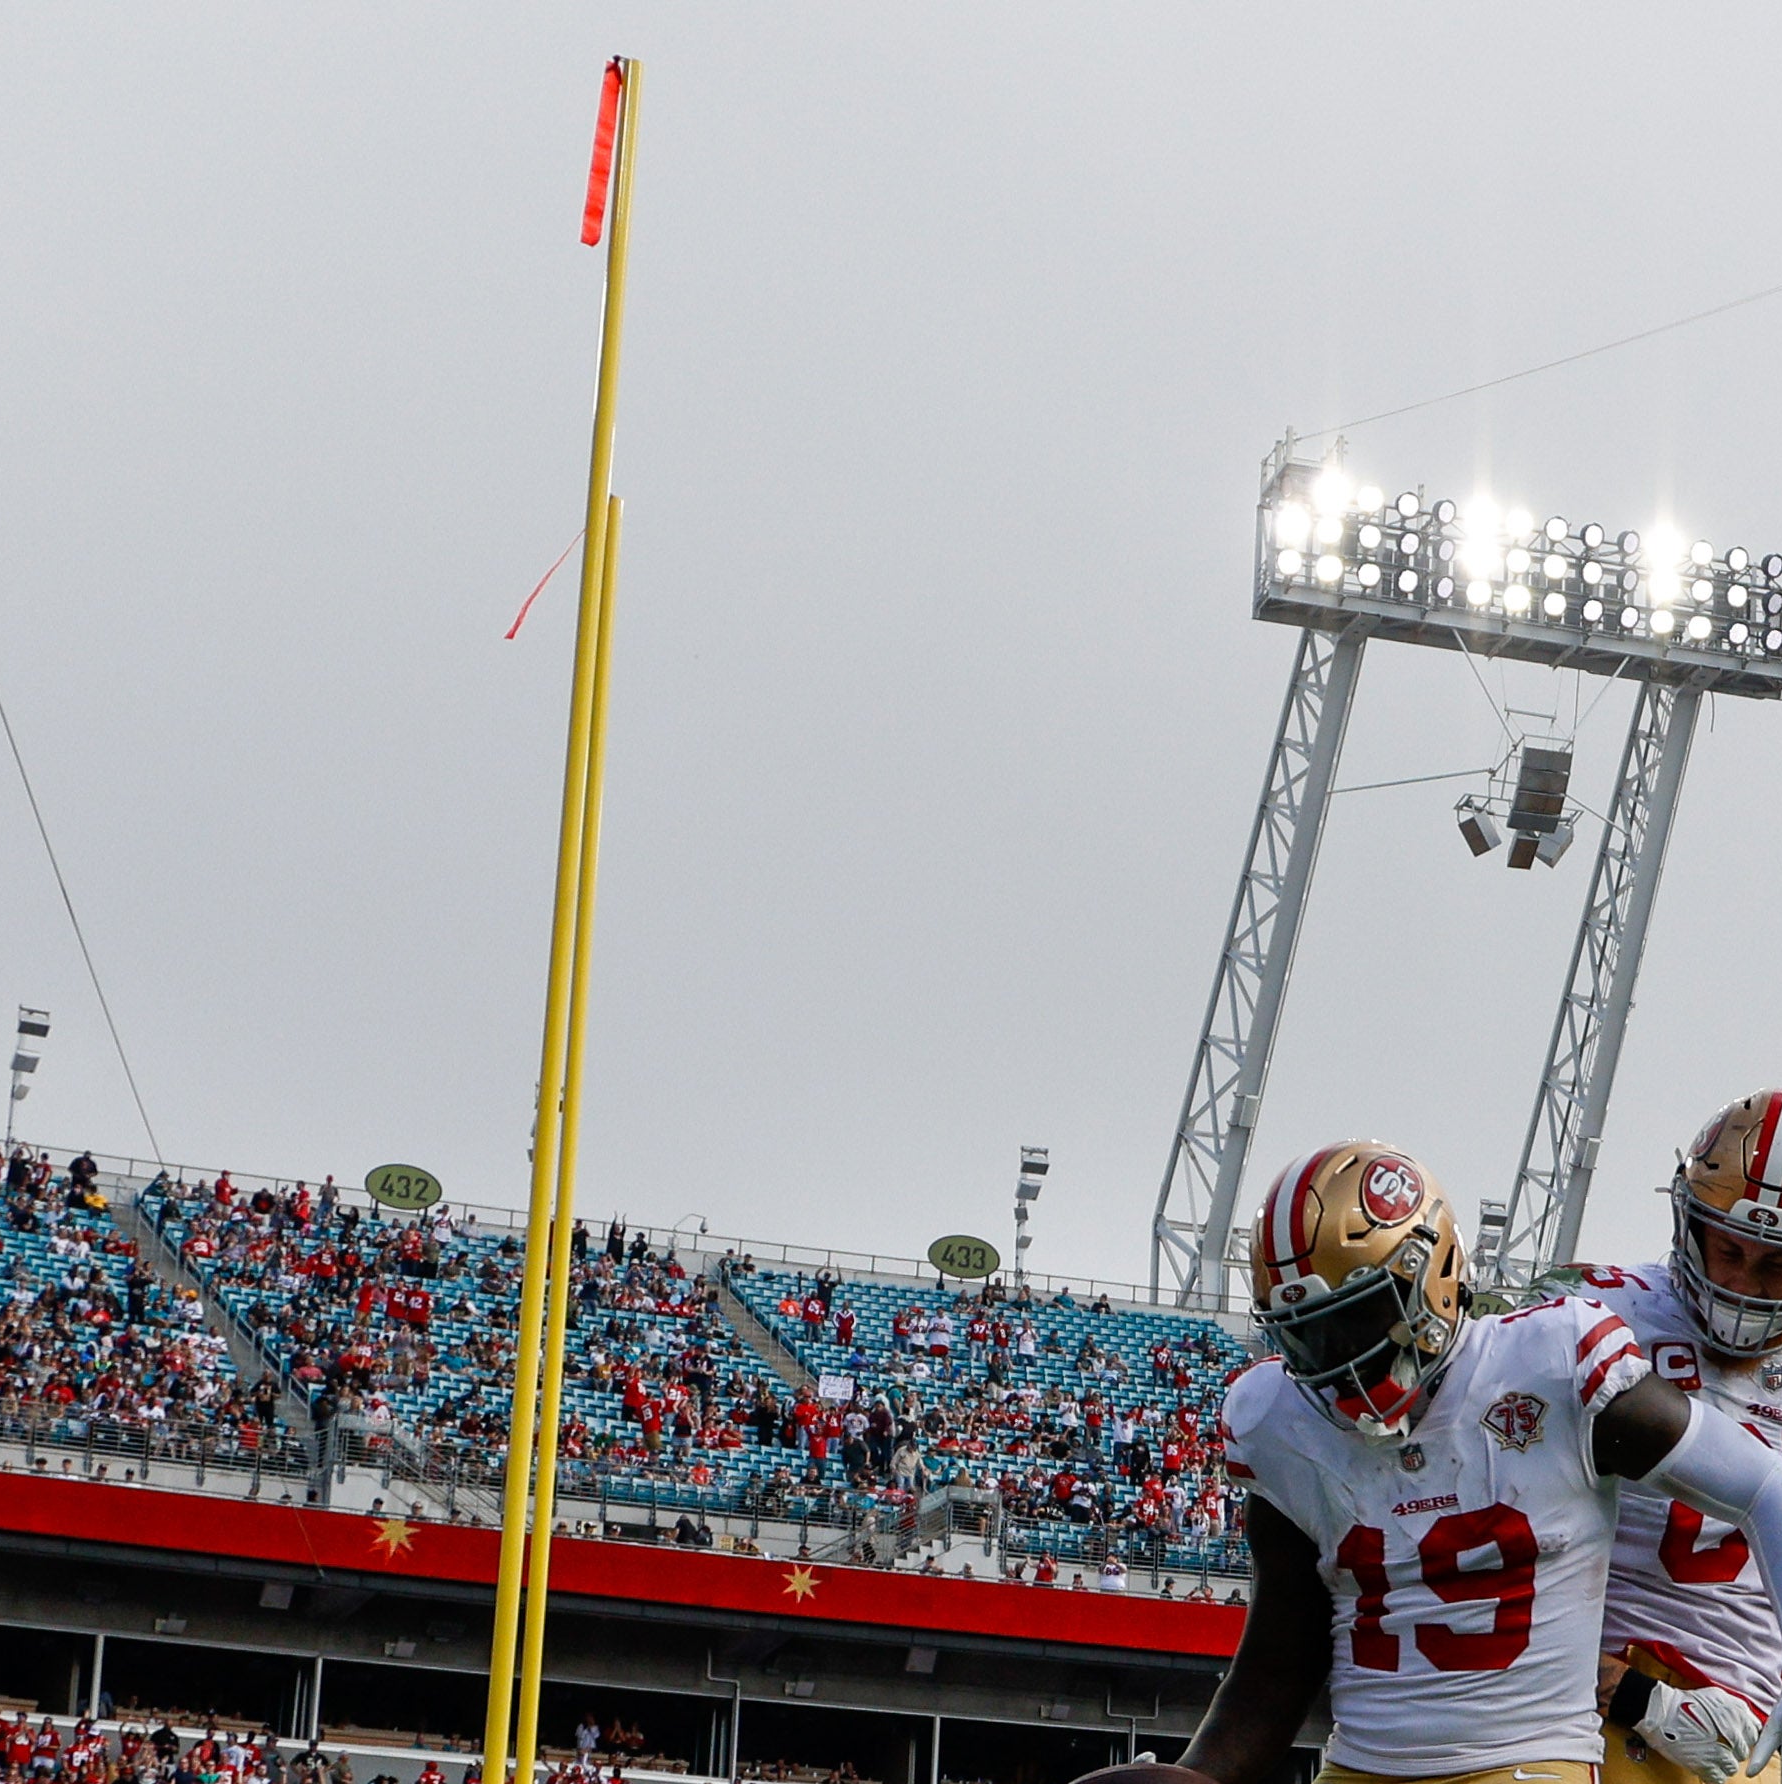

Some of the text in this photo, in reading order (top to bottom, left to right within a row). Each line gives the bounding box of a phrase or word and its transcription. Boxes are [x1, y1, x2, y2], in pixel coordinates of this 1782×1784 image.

[379, 1175, 429, 1201] 432
[942, 1244, 986, 1270] 433
[1655, 1346, 1696, 1380] C
[1495, 1403, 1537, 1435] 75
[1391, 1493, 1459, 1516] 49ERS
[1337, 1502, 1539, 1673] 19
